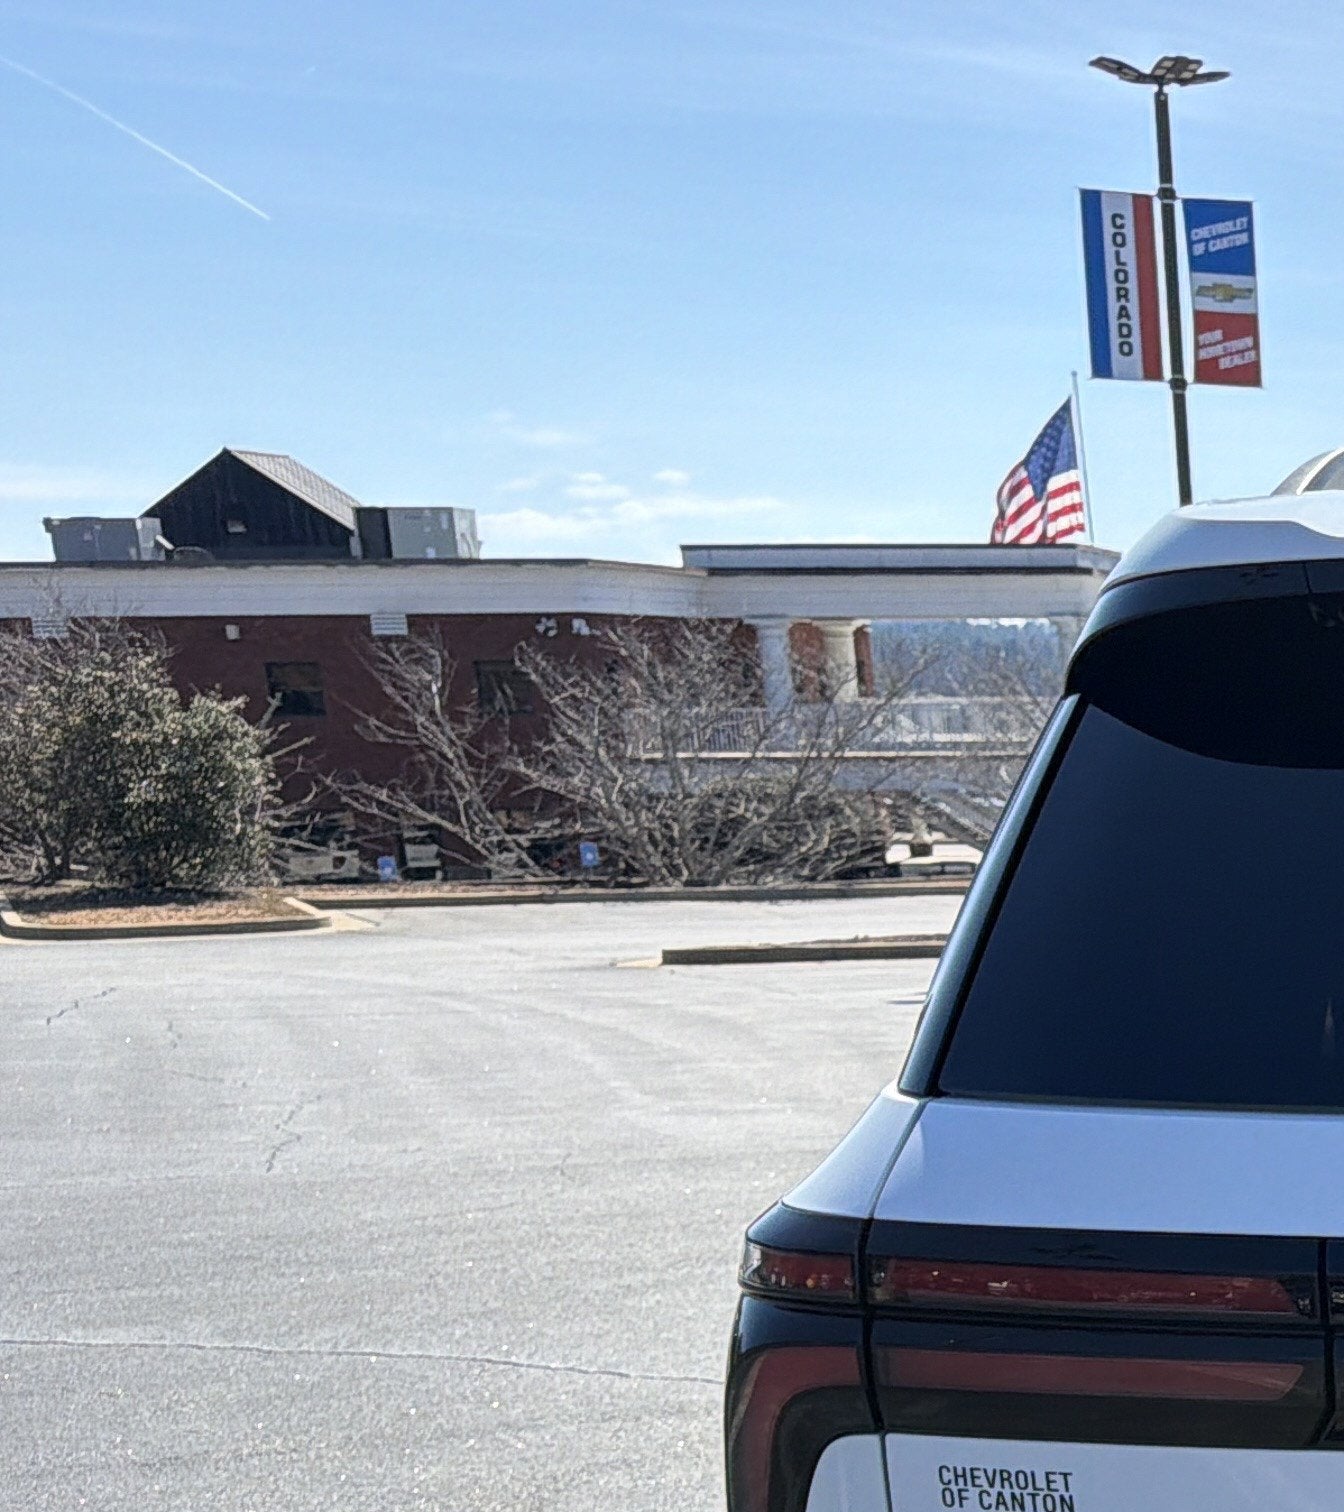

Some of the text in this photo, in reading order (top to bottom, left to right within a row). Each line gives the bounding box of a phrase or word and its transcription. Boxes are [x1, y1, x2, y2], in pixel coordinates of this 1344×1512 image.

[1111, 213, 1133, 357] COLORADO
[938, 1465, 1073, 1493] CHEVROLET
[941, 1487, 970, 1509] OF
